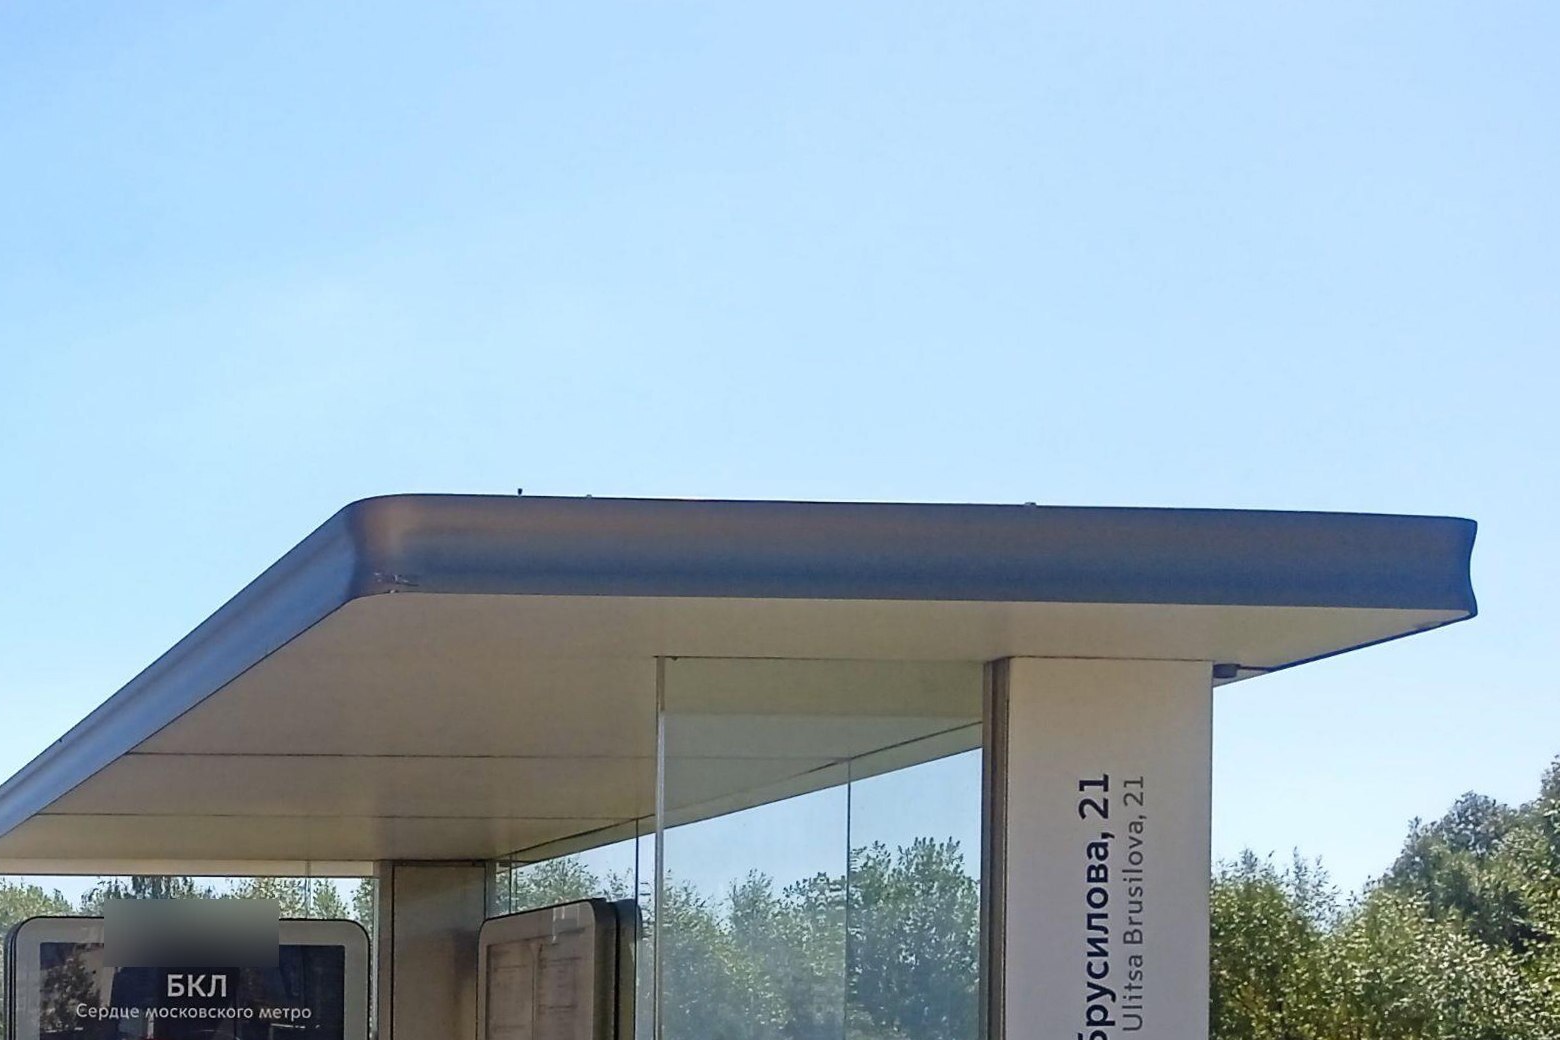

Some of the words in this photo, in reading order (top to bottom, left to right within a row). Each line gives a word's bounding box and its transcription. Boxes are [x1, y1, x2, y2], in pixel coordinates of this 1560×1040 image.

[1077, 773, 1111, 821] 21
[1123, 775, 1144, 808] 21
[1122, 813, 1148, 946] Brusilova,
[167, 973, 228, 998] БКЛ
[1122, 952, 1144, 1032] Ulitsa
[75, 1003, 140, 1021] Сердце
[145, 1004, 254, 1020] московского
[258, 1006, 313, 1022] метро
